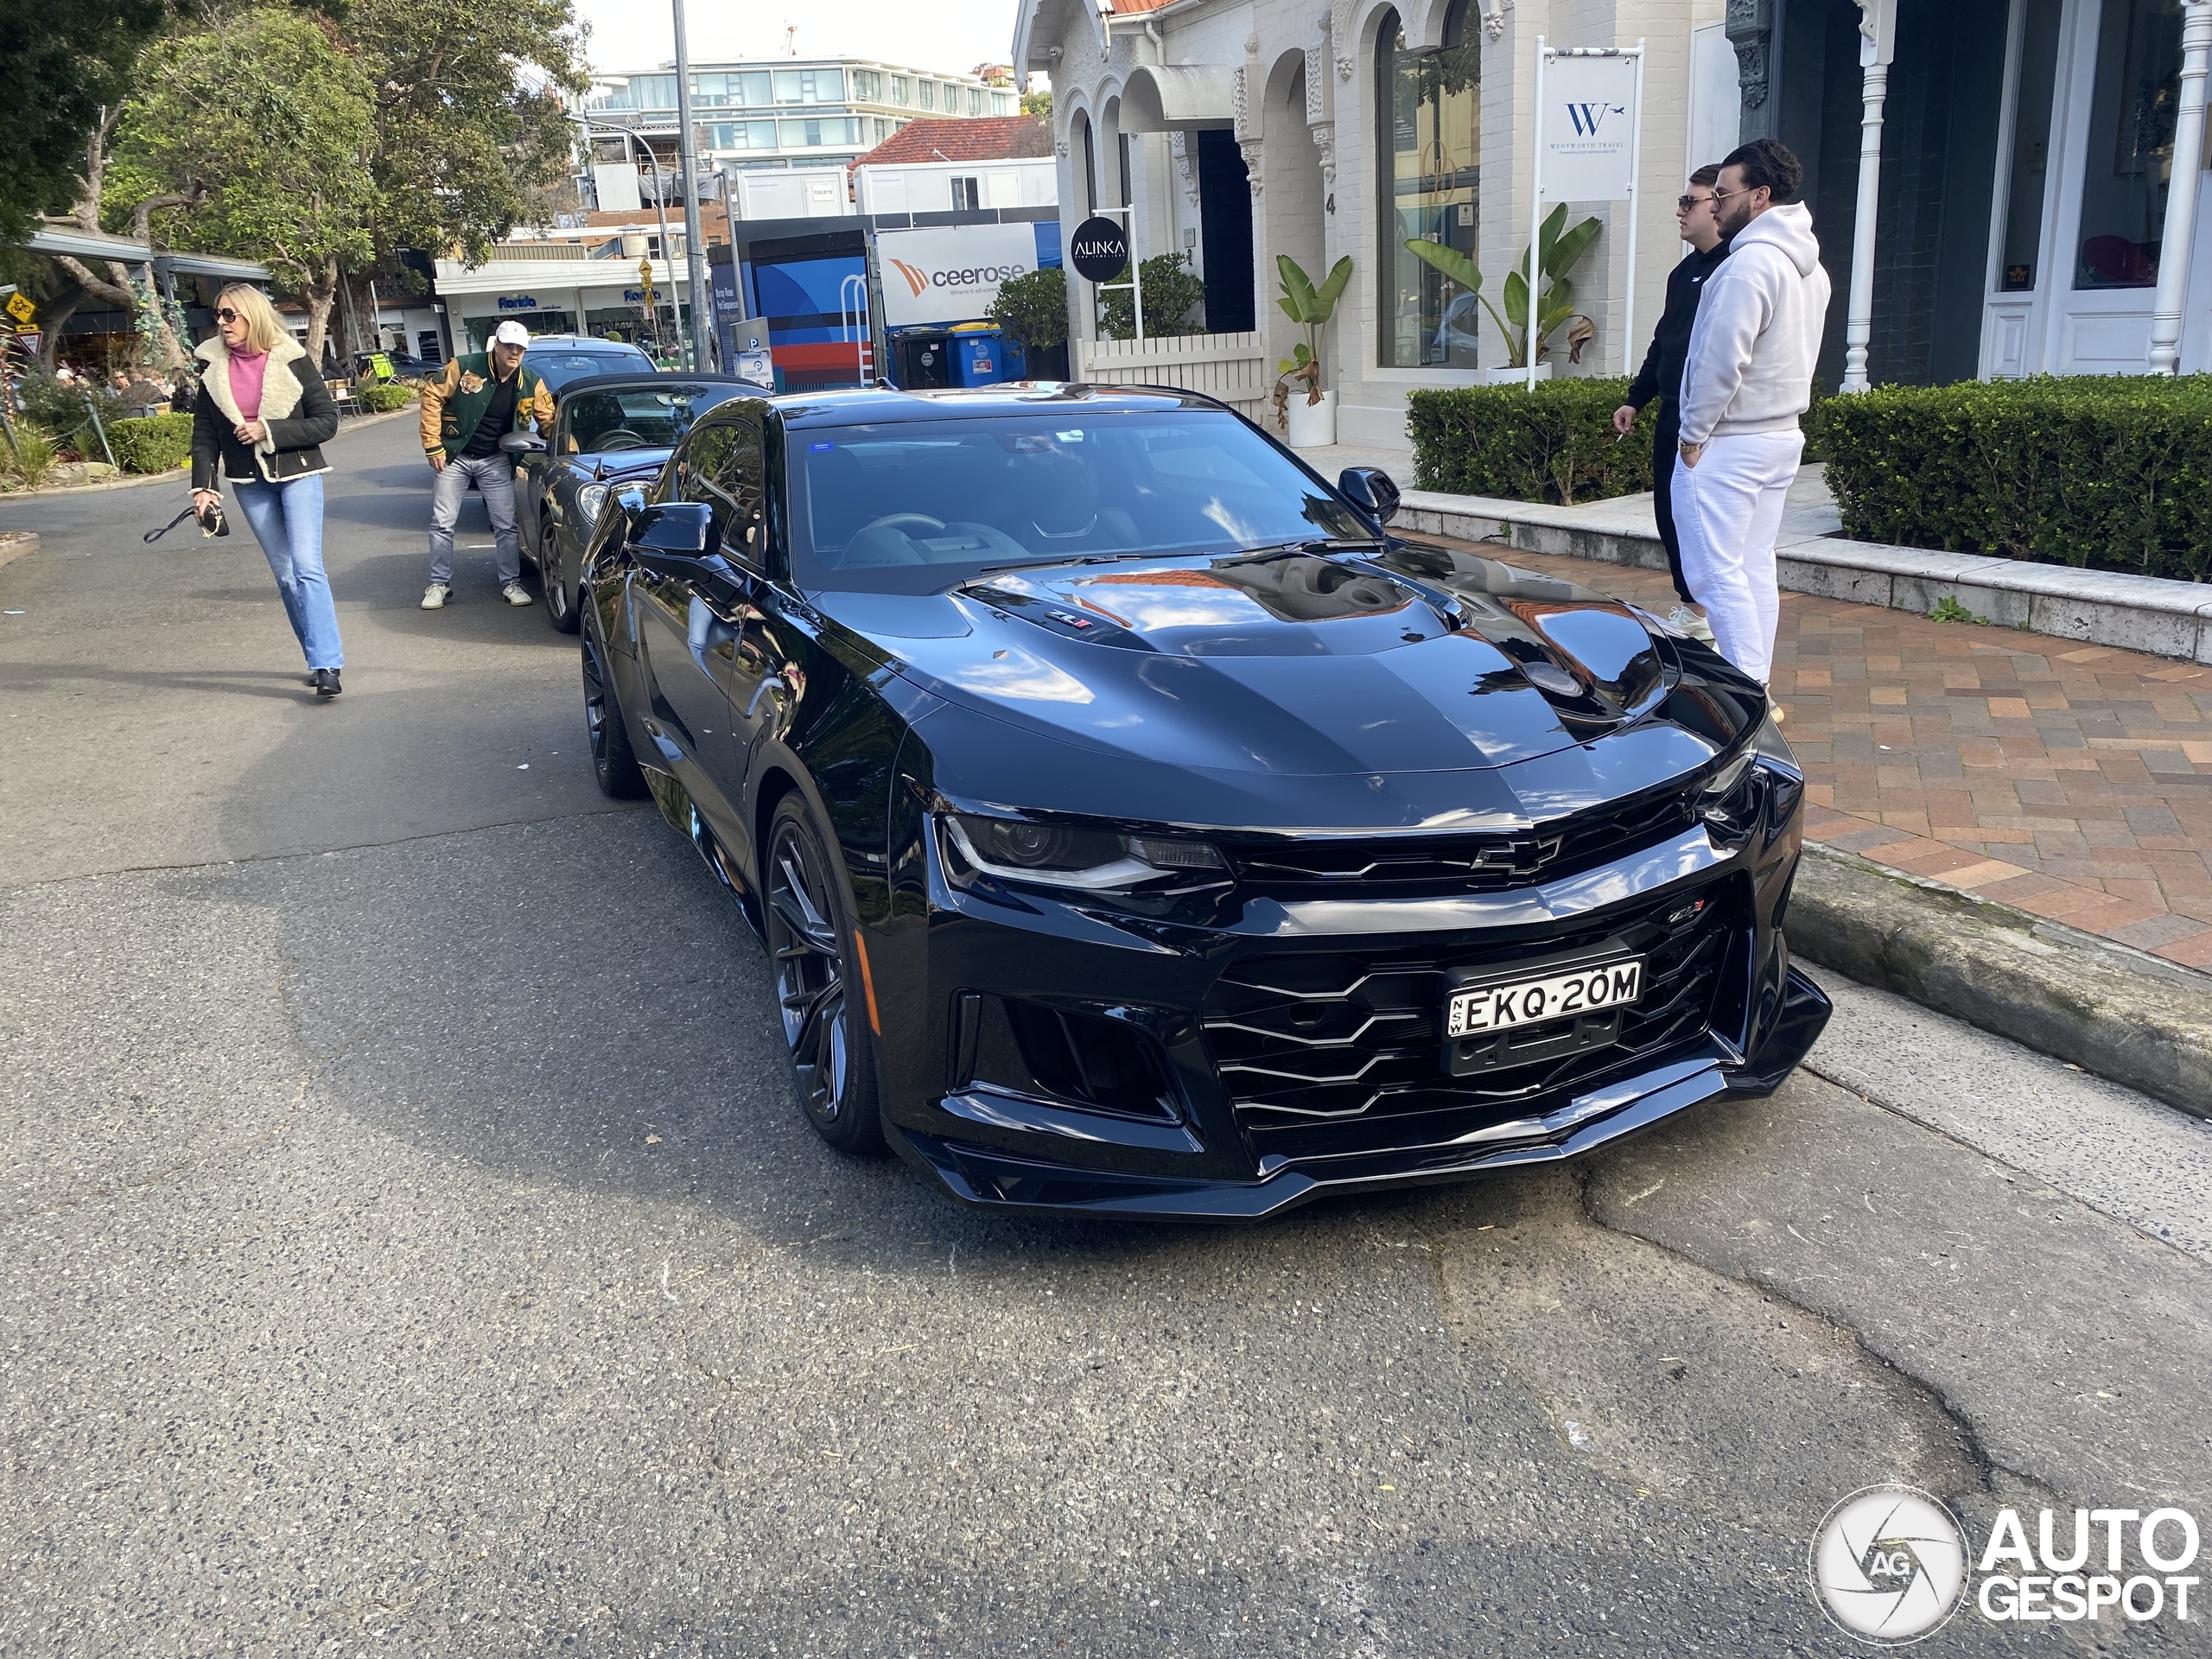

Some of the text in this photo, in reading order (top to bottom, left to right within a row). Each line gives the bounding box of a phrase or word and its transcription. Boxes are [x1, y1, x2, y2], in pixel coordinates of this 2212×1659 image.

[1325, 193, 1336, 215] 4
[1074, 240, 1125, 255] ALINKA
[932, 264, 1026, 288] ceerose
[750, 339, 758, 348] P
[1450, 1000, 1463, 1033] NSW
